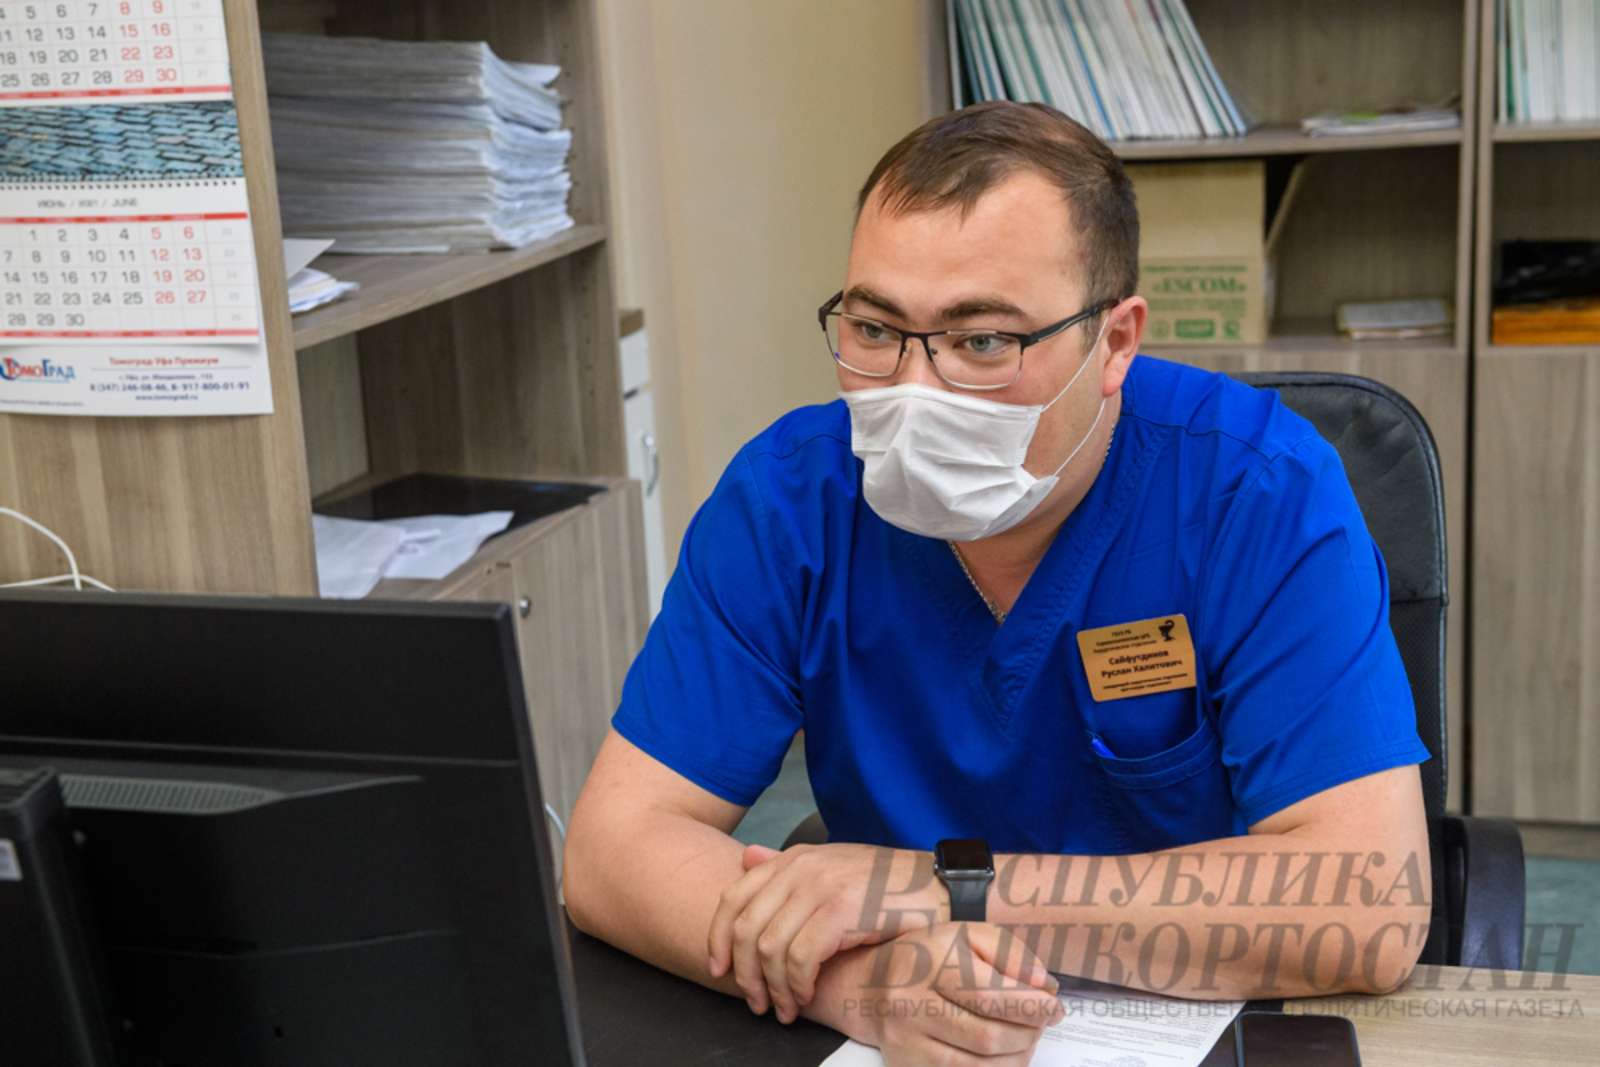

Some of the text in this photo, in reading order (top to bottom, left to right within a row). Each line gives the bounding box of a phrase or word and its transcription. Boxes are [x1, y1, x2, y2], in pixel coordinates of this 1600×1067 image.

[25, 5, 36, 19] 5
[56, 4, 67, 18] 6
[88, 3, 98, 16] 7
[120, 1, 130, 15] 8
[152, 0, 163, 13] 9
[26, 28, 43, 42] 12
[56, 27, 75, 40] 13
[88, 26, 106, 38] 14
[119, 24, 138, 37] 15
[152, 22, 171, 36] 16
[0, 51, 17, 65] 18
[29, 50, 47, 64] 19
[58, 49, 78, 63] 20
[89, 48, 107, 62] 21
[121, 46, 140, 61] 22
[153, 45, 174, 59] 23
[0, 73, 20, 87] 25
[30, 72, 50, 86] 26
[61, 71, 80, 85] 27
[92, 70, 112, 84] 28
[124, 69, 144, 83] 29
[156, 68, 177, 82] 30
[30, 229, 36, 241] 1
[57, 229, 67, 242] 2
[88, 228, 98, 241] 3
[119, 228, 129, 239] 4
[151, 227, 162, 240] 5
[183, 226, 194, 239] 6
[5, 250, 12, 262] 7
[32, 250, 41, 263] 8
[60, 250, 70, 263] 9
[88, 250, 106, 263] 10
[119, 250, 135, 261] 11
[151, 248, 169, 261] 12
[183, 248, 202, 261] 13
[4, 272, 20, 283] 14
[32, 271, 49, 285] 15
[61, 271, 78, 284] 16
[91, 271, 107, 283] 17
[122, 271, 140, 283] 18
[154, 270, 172, 282] 19
[184, 269, 205, 282] 20
[5, 292, 22, 305] 21
[33, 292, 51, 305] 22
[62, 292, 81, 306] 23
[92, 292, 111, 305] 24
[123, 292, 143, 305] 25
[155, 291, 175, 304] 26
[187, 290, 206, 303] 27
[8, 313, 26, 326] 28
[36, 313, 55, 326] 29
[66, 313, 85, 326] 30
[1108, 650, 1169, 666] Сайфутдинов
[1101, 659, 1183, 679] Руслан Халитович
